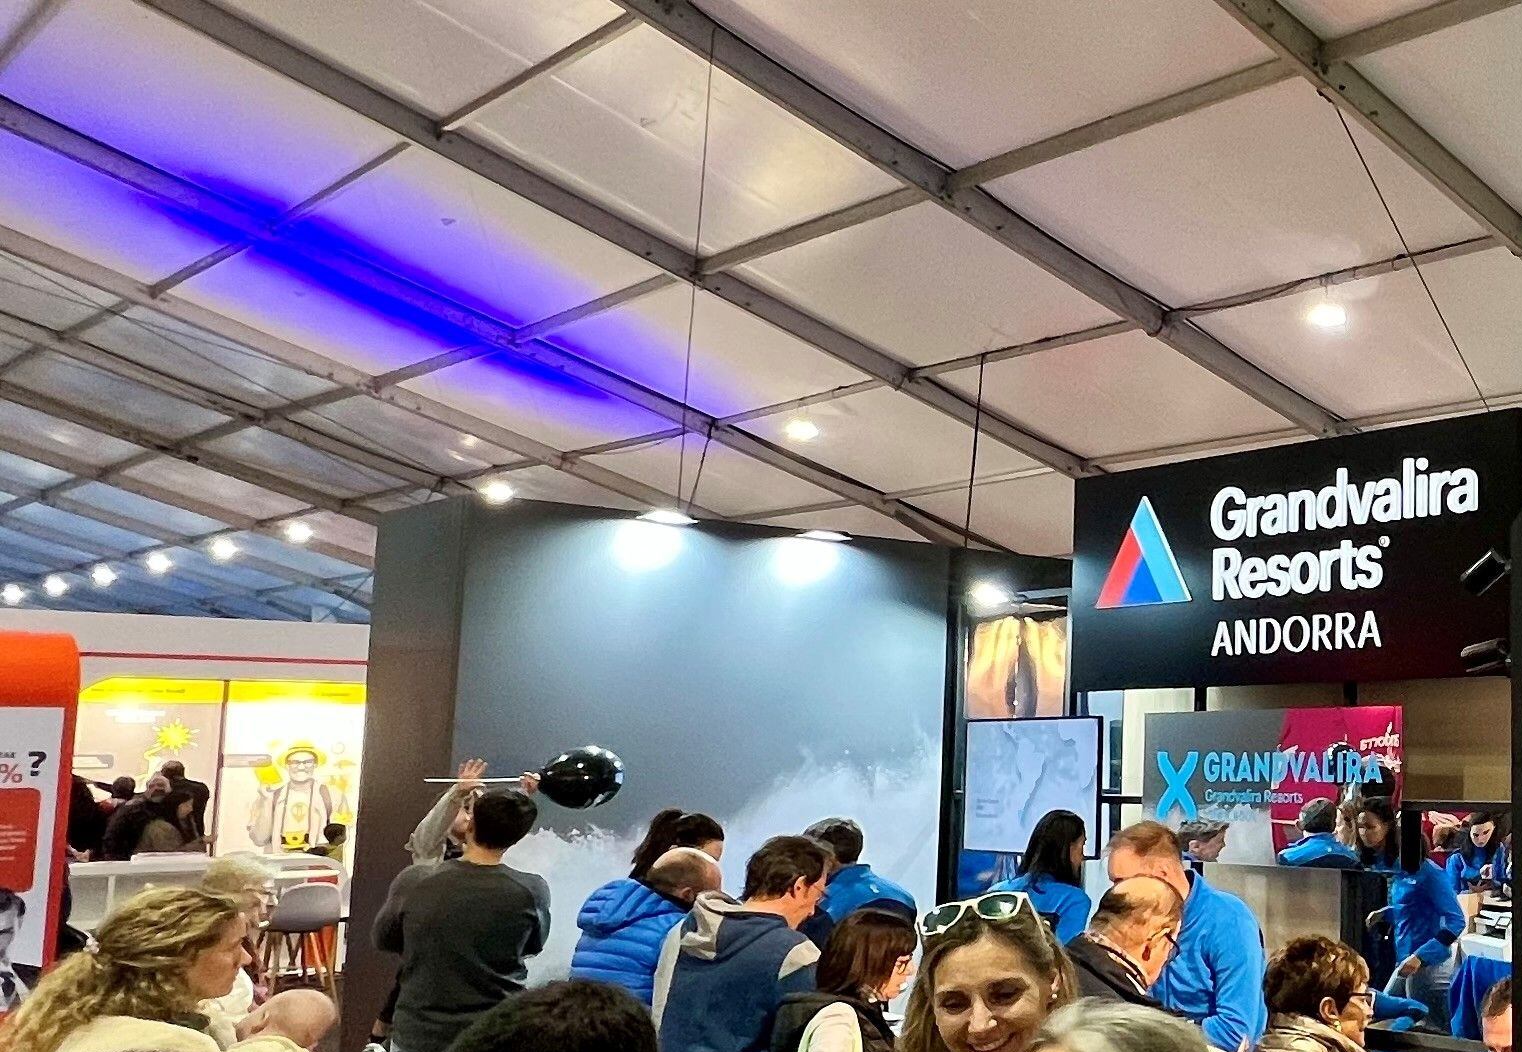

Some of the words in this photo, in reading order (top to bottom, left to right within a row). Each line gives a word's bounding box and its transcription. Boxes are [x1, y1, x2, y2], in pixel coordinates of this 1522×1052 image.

[1210, 457, 1479, 541] Grandvalira
[1210, 610, 1382, 657] ANDORRA
[1203, 751, 1383, 783] GRANDVALIRA
[1204, 788, 1262, 803] Grandvalira
[1263, 789, 1304, 804] Resorts
